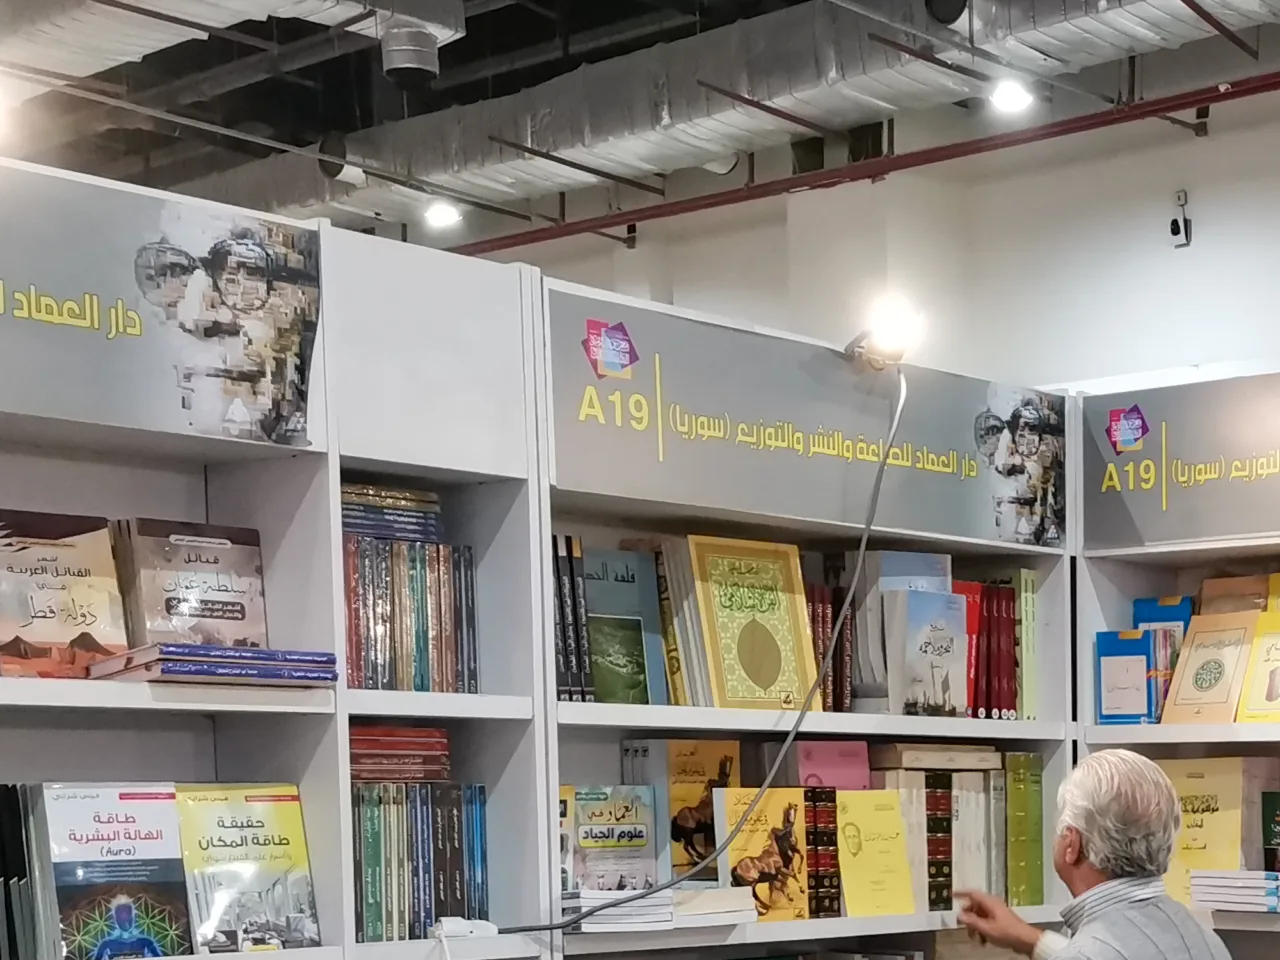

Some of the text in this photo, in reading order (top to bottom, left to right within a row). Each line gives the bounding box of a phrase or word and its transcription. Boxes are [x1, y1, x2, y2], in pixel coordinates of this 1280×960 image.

[13, 283, 143, 340] دار العماد
[577, 384, 651, 432] A19
[668, 402, 979, 481] دار العماد للطاعة والنشر والتوزيع (سوريا)
[1100, 459, 1157, 494] A19
[1171, 454, 1226, 488] (سوريا)
[183, 553, 221, 565] قبائل
[5, 564, 92, 579] القبائل العربية
[92, 811, 137, 826] طاقة
[216, 815, 266, 830] حقيقة
[68, 828, 164, 846] الهالة البشرية
[198, 833, 290, 851] طاقة المكان
[581, 827, 645, 843] علوم الجياد
[99, 844, 137, 857] (Aura)
